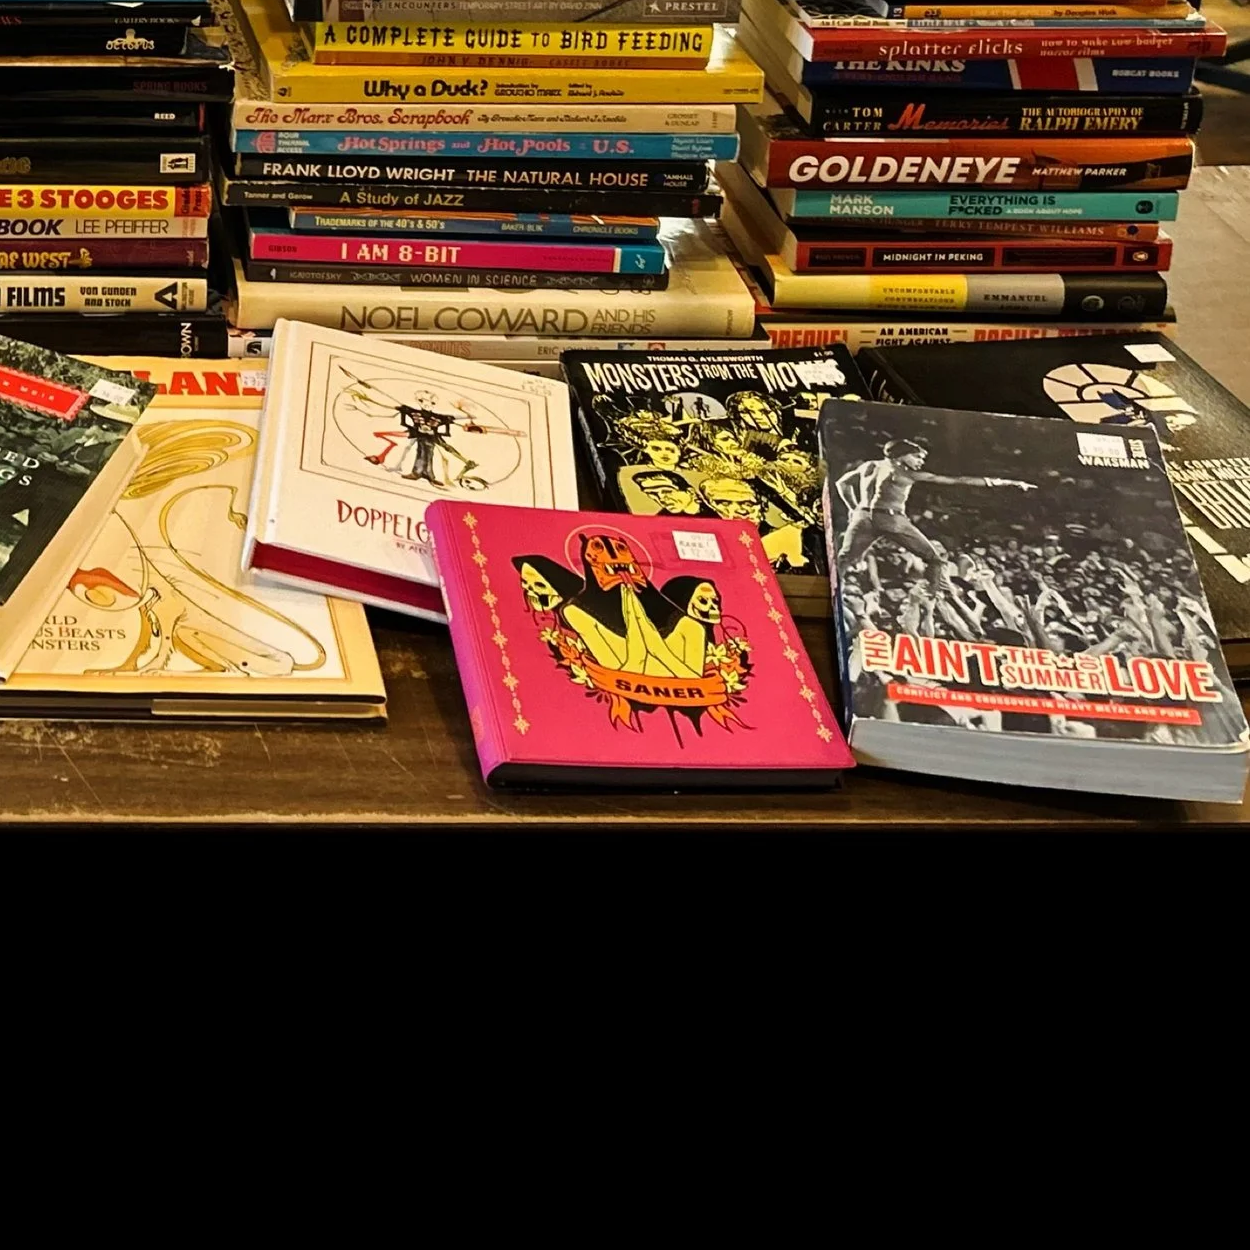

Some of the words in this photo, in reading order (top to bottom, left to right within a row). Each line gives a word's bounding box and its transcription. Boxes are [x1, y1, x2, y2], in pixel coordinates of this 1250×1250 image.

[665, 2, 718, 11] PRESTEL
[364, 80, 408, 98] Why
[415, 82, 428, 98] a
[431, 79, 488, 97] Duck?
[263, 163, 321, 177] FRANK
[328, 165, 379, 179] LLOYD
[386, 167, 455, 181] WRIGHT
[467, 168, 497, 183] THE
[504, 170, 583, 185] NATURAL
[590, 171, 648, 186] HOUSE
[789, 156, 1020, 184] GOLDENEYE
[1032, 166, 1082, 177] MATTHEW
[1085, 167, 1127, 176] PARKER
[18, 189, 33, 209] 3
[40, 190, 169, 210] STOOGES
[340, 191, 351, 204] A
[356, 192, 398, 208] Study
[403, 193, 419, 204] of
[423, 194, 464, 206] JAZZ
[830, 194, 873, 205] MARK
[950, 195, 1039, 206] EVERYTHING
[1043, 196, 1056, 205] IS
[830, 205, 894, 215] MANSON
[75, 220, 100, 235] LEE
[105, 220, 169, 234] PFEIFFER
[341, 243, 347, 258] I
[356, 243, 389, 260] AM
[398, 245, 461, 264] 8-BIT
[883, 252, 930, 262] MIDNIGHT
[935, 253, 945, 261] IN
[949, 253, 983, 262] PEKING
[6, 286, 65, 307] FILMS
[582, 362, 700, 393] MONSTERS
[697, 364, 730, 380] FROM
[731, 364, 758, 380] THE
[1078, 454, 1150, 469] WAKSMAN
[893, 636, 1001, 685] AIN'T
[1104, 654, 1222, 701] LOVE
[615, 679, 704, 699] SANER
